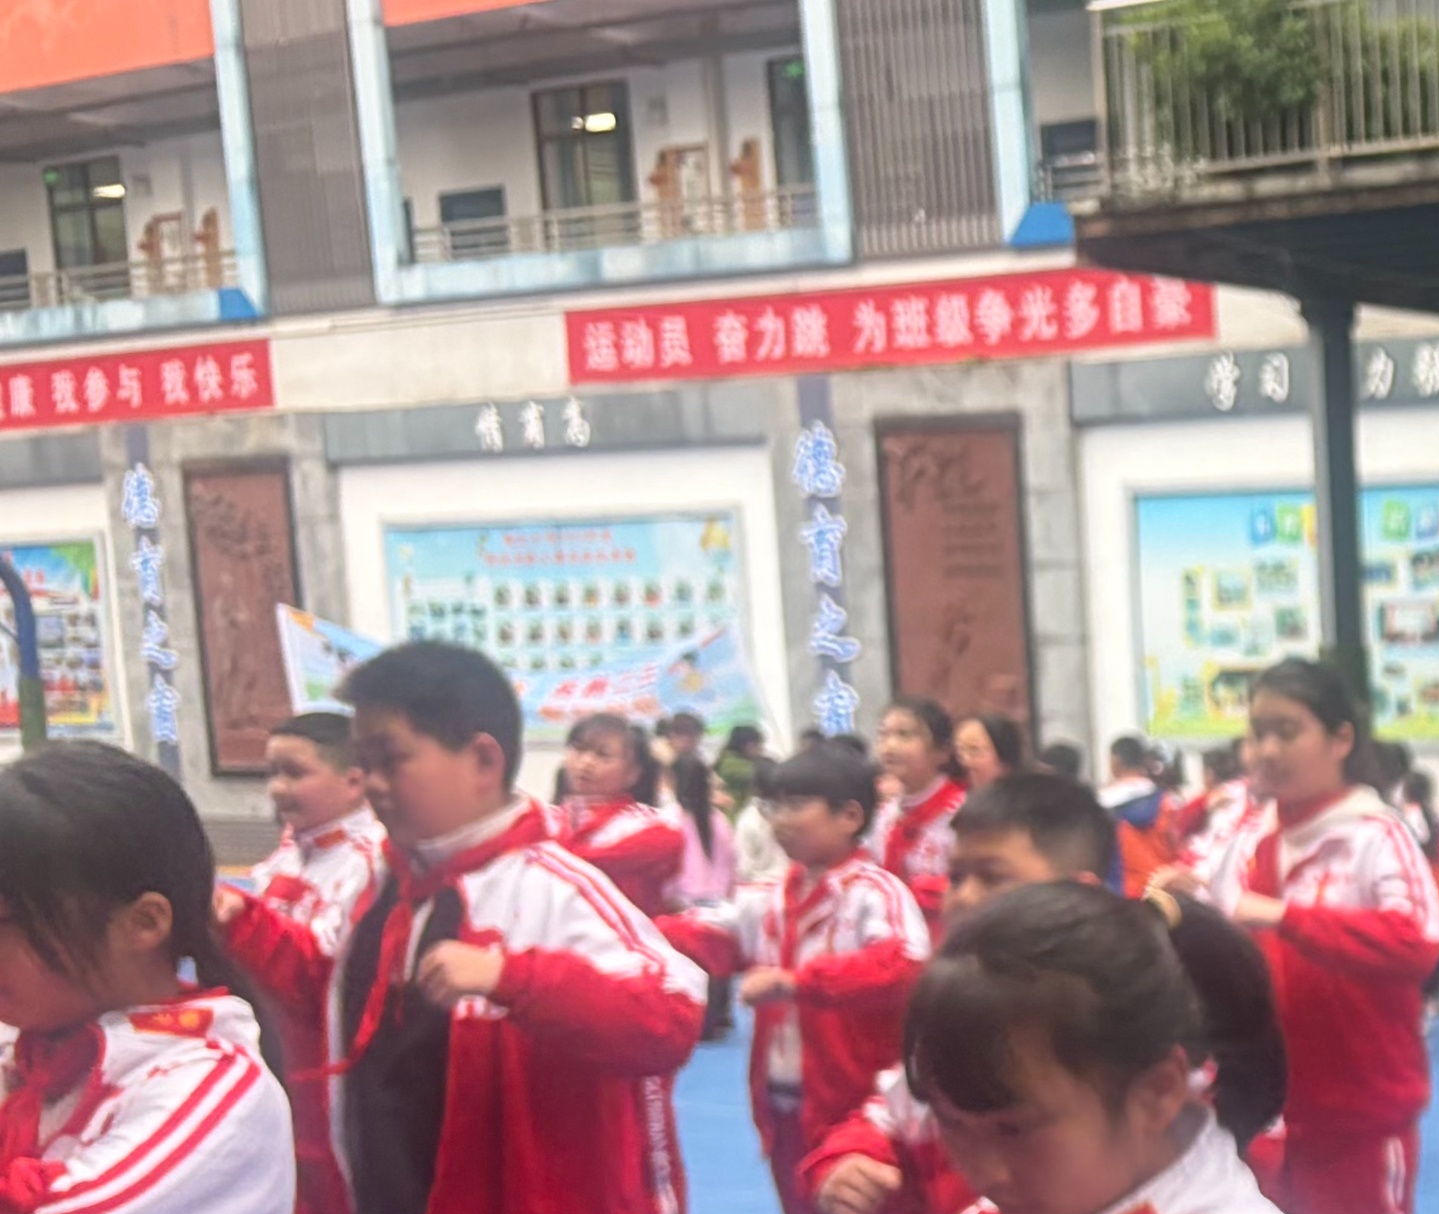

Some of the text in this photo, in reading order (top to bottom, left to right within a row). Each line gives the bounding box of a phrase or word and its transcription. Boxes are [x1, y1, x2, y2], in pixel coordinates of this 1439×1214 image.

[584, 276, 1194, 373] 运动员 奋力跳 为班级争光多自豪
[50, 363, 143, 414] 我参与
[160, 352, 259, 406] 我快乐
